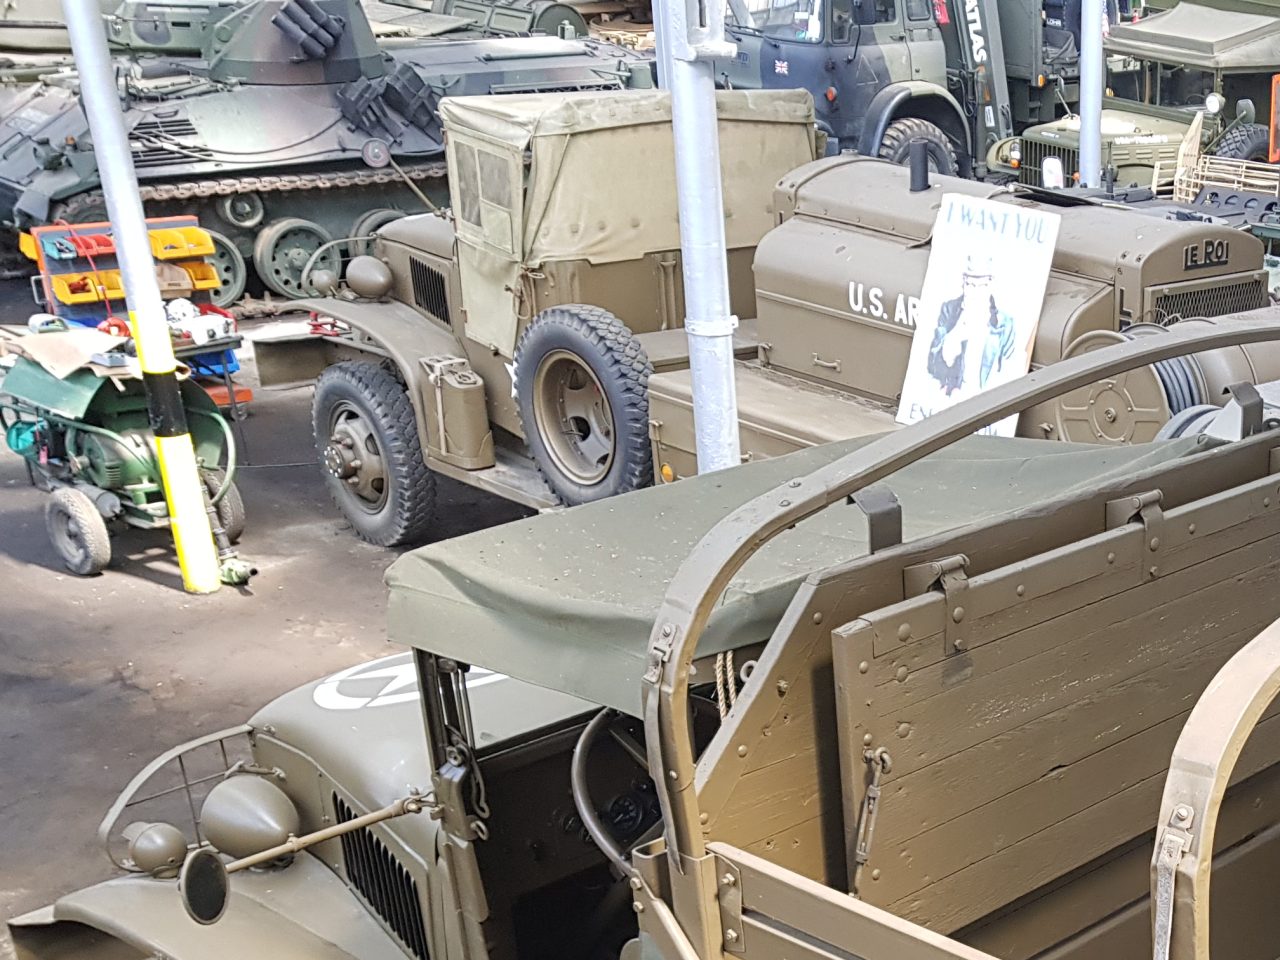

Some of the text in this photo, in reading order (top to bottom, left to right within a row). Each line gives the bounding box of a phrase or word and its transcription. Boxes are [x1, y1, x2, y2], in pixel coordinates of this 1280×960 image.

[964, 0, 987, 63] ATLAS
[947, 201, 1047, 244] I WANT YOU
[1204, 238, 1229, 267] ROI
[849, 281, 888, 320] U.S.
